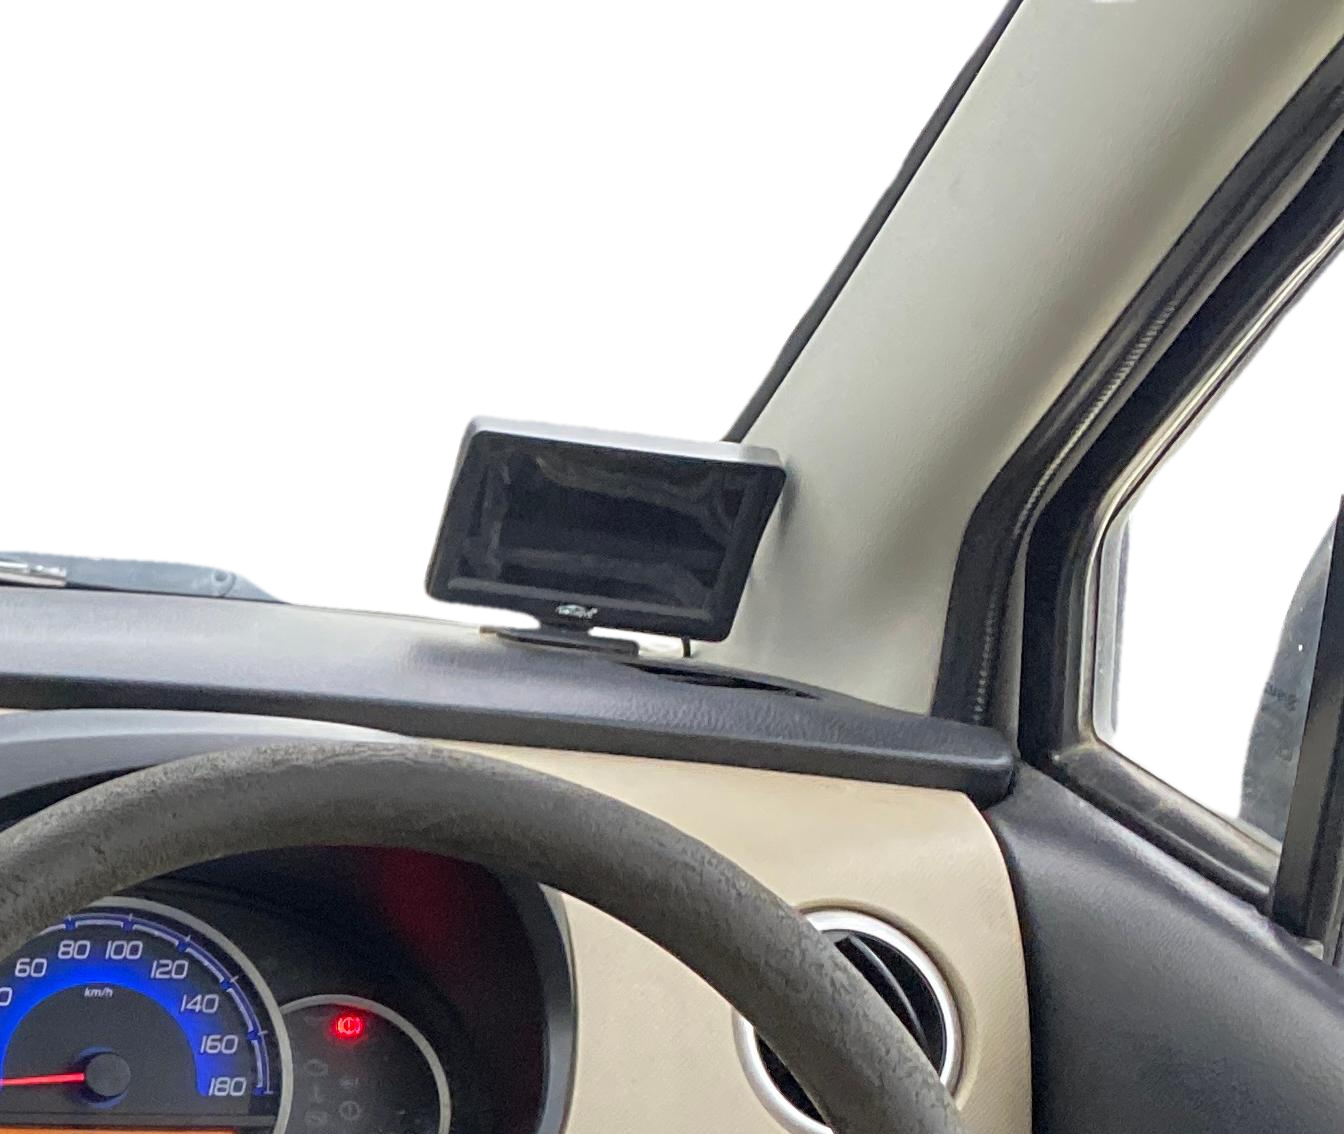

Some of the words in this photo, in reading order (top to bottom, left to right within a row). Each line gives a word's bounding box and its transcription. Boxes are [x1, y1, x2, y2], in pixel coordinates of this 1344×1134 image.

[57, 940, 91, 959] 80
[105, 940, 143, 960] 100
[15, 958, 47, 978] 60
[150, 960, 189, 980] 120
[84, 986, 113, 998] km/h
[180, 994, 219, 1014] 140
[200, 1035, 238, 1055] 160
[208, 1077, 246, 1096] 180
